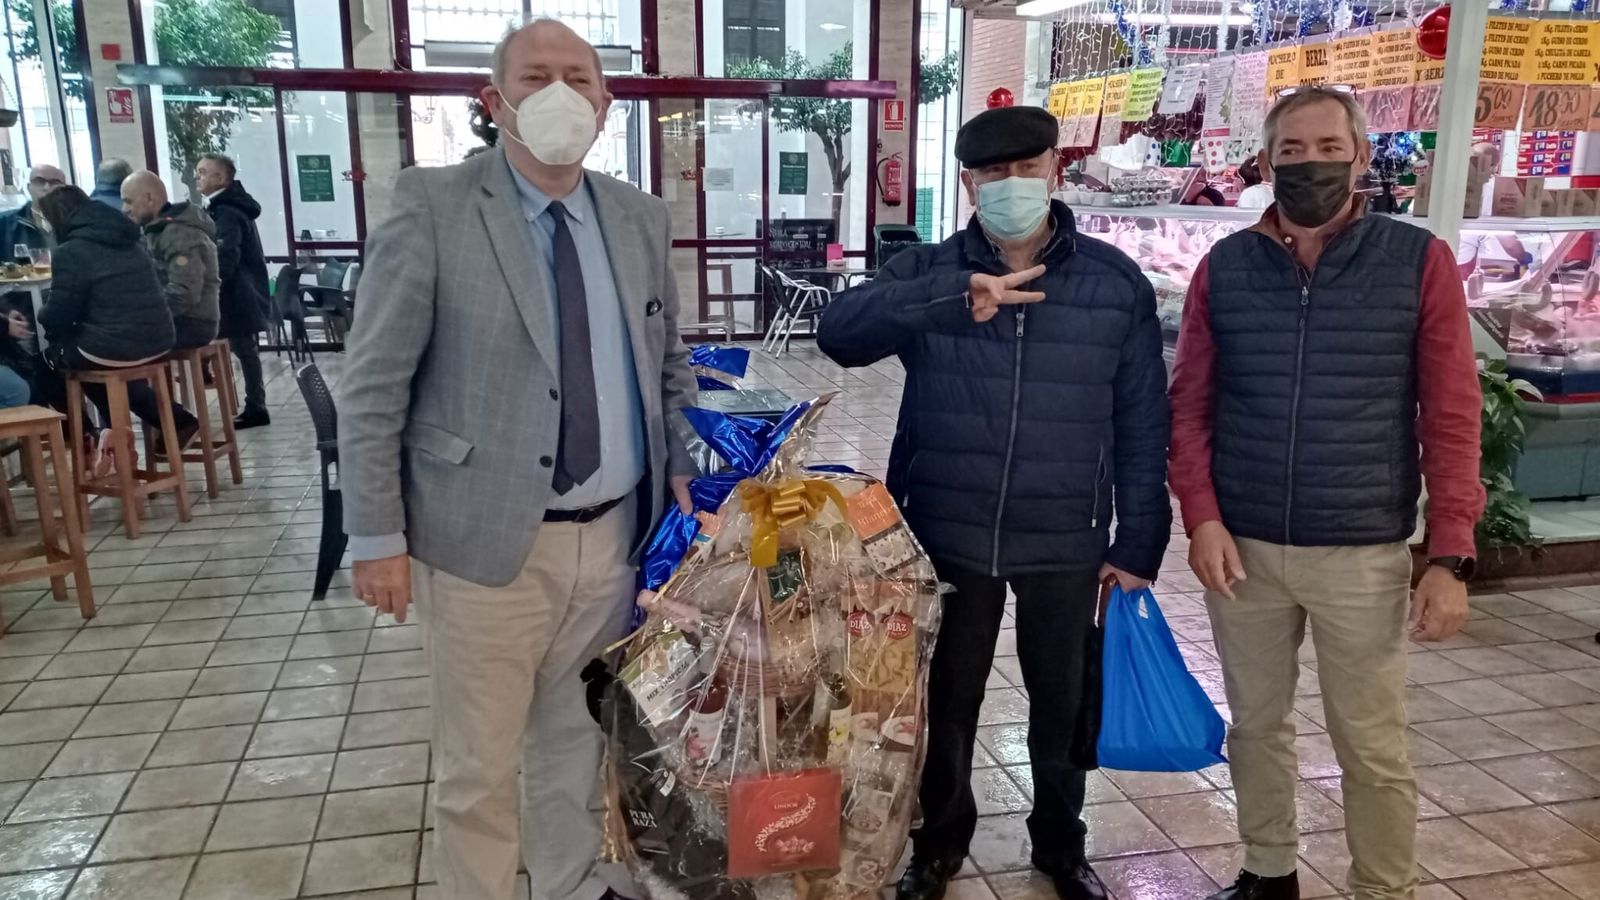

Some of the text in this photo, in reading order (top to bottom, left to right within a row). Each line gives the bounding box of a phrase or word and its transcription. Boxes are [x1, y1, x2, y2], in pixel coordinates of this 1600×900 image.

[1305, 48, 1328, 67] BERZA
[1276, 69, 1285, 80] DE
[1480, 70, 1498, 79] UCHERO
[646, 690, 660, 702] MIX
